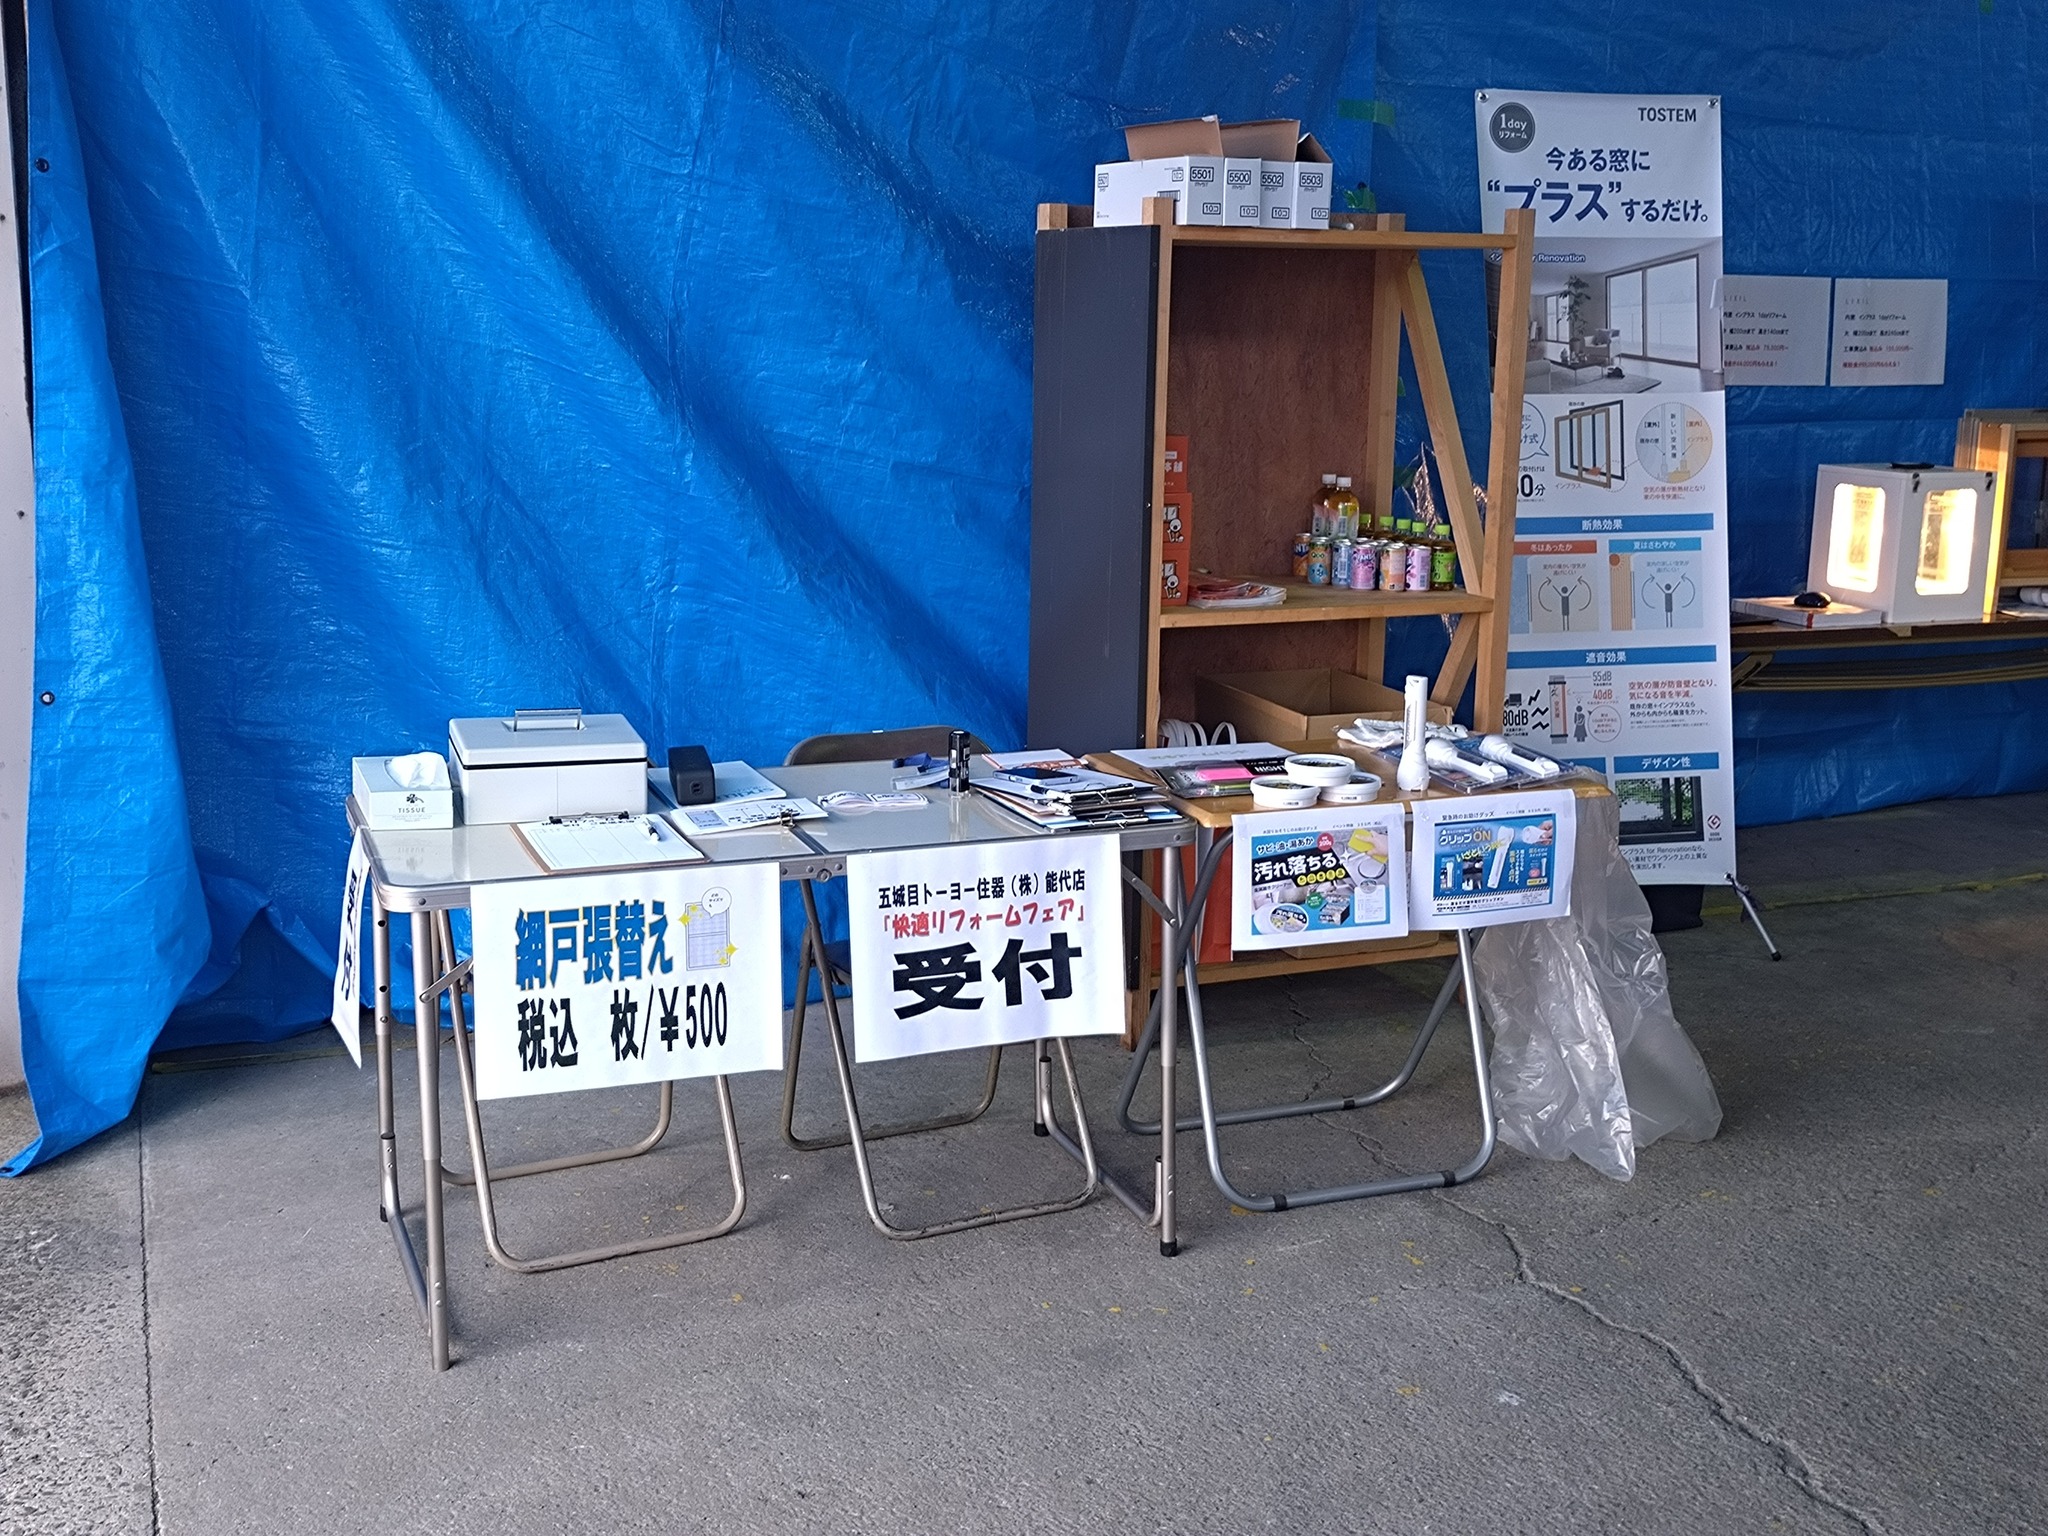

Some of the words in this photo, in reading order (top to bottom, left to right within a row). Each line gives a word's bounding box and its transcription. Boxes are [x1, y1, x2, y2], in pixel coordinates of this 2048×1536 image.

[1638, 107, 1697, 122] TOSTEM
[1500, 113, 1527, 131] 1day
[1498, 131, 1527, 139] リフォーム
[1546, 147, 1651, 172] 今ある窓に
[1191, 168, 1212, 180] 5501
[1229, 172, 1250, 183] 5500
[1262, 174, 1282, 185] 5502
[1301, 175, 1321, 186] 5503
[1538, 252, 1586, 263] Renovation
[1555, 482, 1582, 490] インプラス
[1581, 518, 1624, 531] 断熱効果
[1530, 543, 1573, 553] 冬はあったか
[1633, 541, 1676, 550] 夏はさわやか
[1585, 651, 1627, 664] 遮音効果
[1592, 670, 1612, 681] 55dB
[1592, 689, 1613, 700] 40dB
[1628, 690, 1694, 700] 気になる音を半減。
[1503, 709, 1529, 726] 80dB
[1641, 756, 1691, 770] デザイン性
[1442, 811, 1495, 821] 緊急時のお助けグッズ
[883, 897, 1084, 940] 「快適リフォームフェア」
[514, 898, 674, 991] 網戸張替え
[892, 931, 1083, 1021] 受付
[517, 997, 579, 1072] 税込
